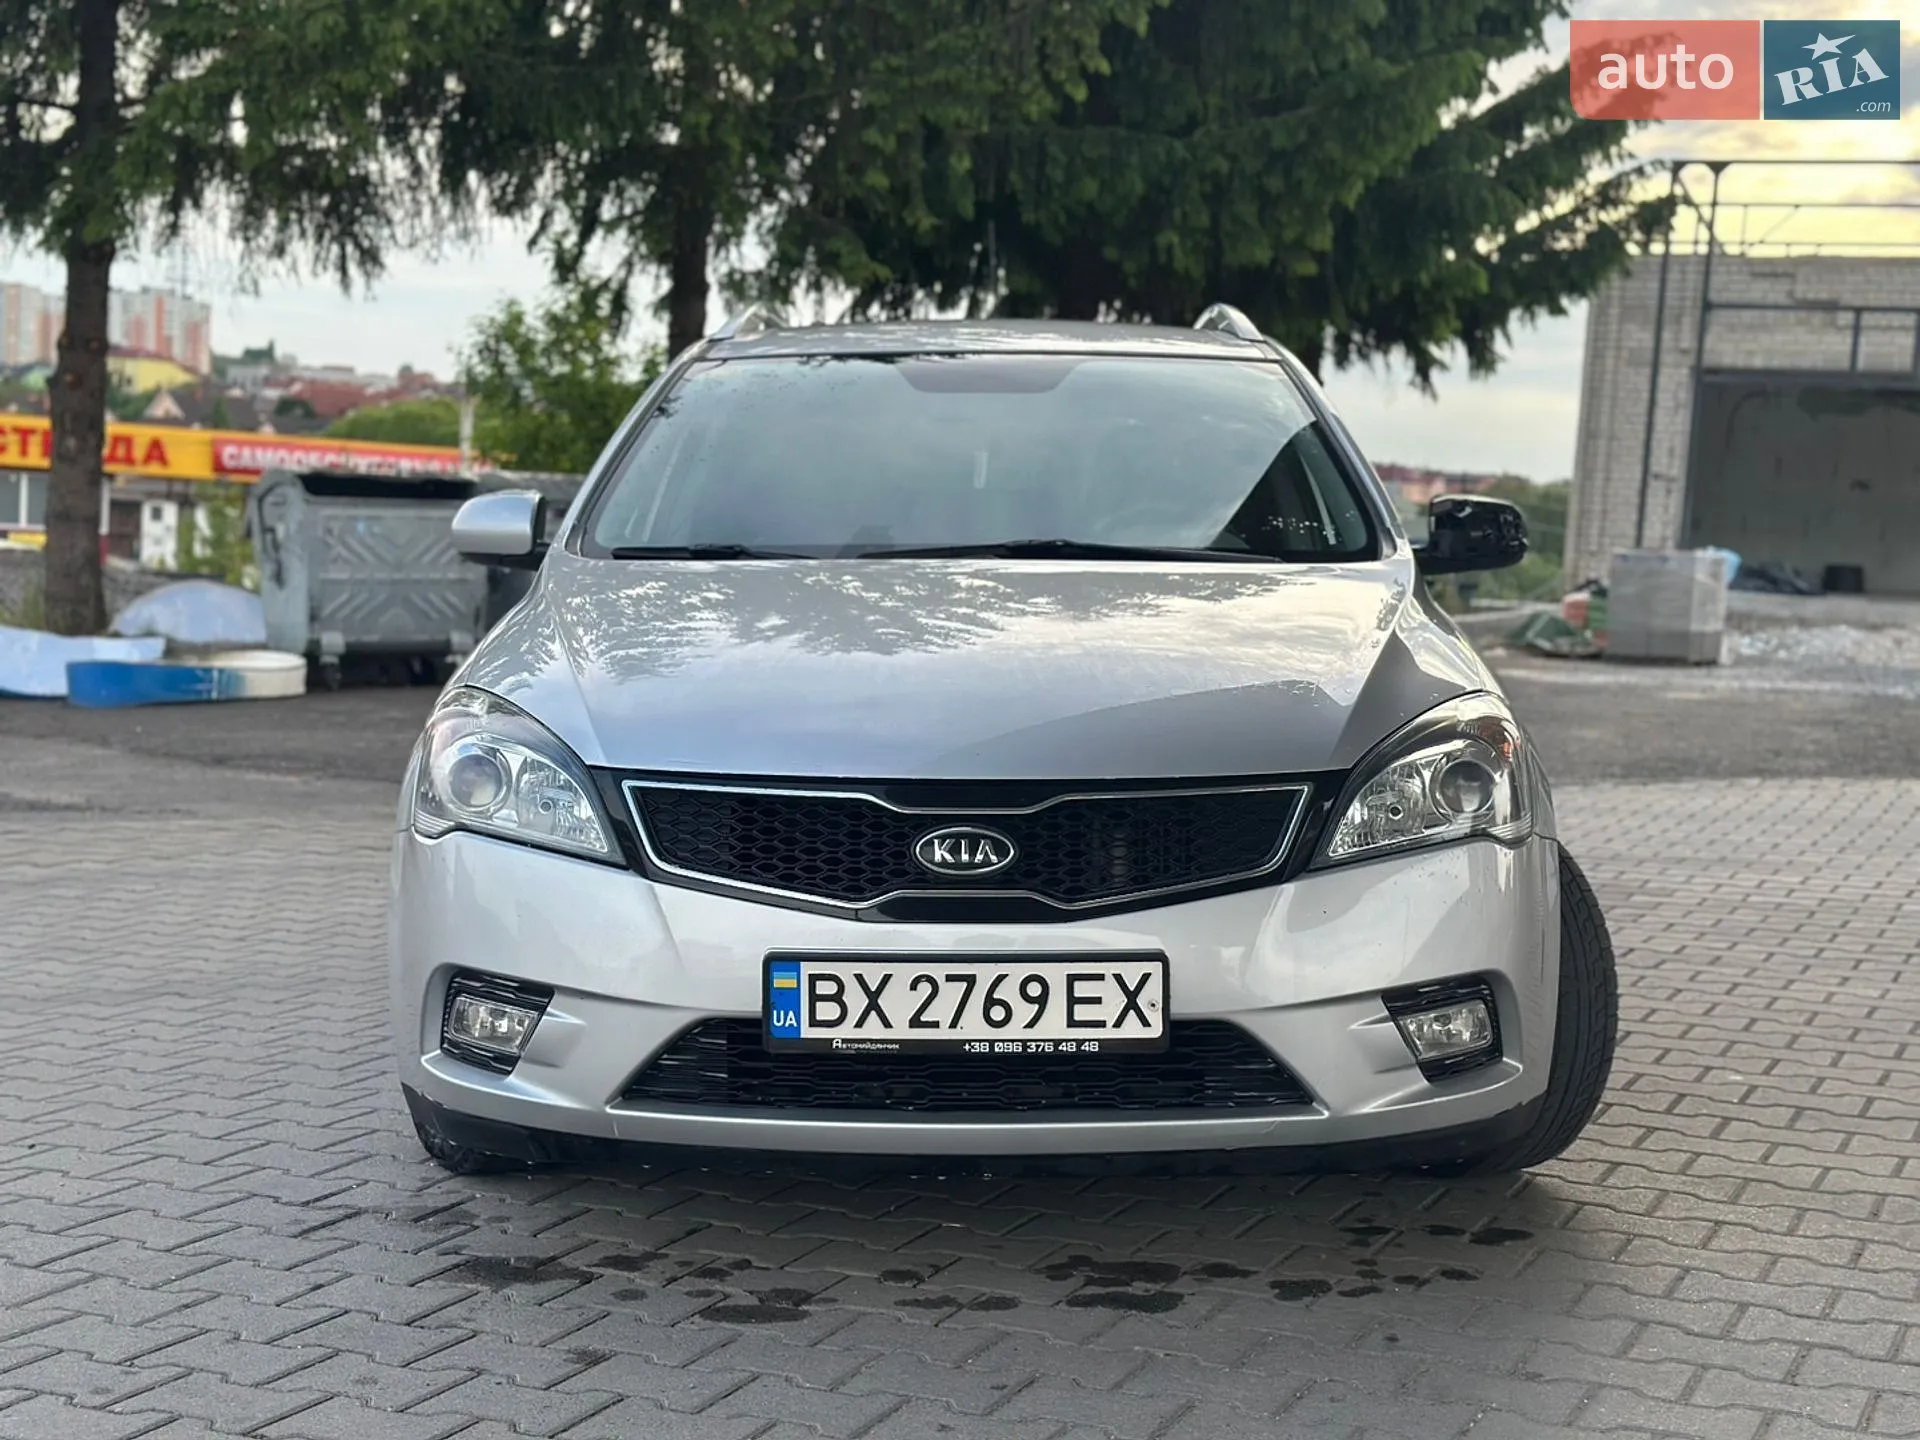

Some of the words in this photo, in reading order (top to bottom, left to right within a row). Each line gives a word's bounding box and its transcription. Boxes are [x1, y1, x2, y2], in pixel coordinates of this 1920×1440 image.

[933, 838, 998, 863] KIA
[807, 972, 894, 1029] BX
[908, 972, 1050, 1029] 2769
[1066, 972, 1153, 1029] EX
[772, 1012, 797, 1028] UA
[963, 1041, 990, 1052] +38
[994, 1041, 1022, 1052] 096
[1026, 1041, 1054, 1052] 376
[1058, 1041, 1076, 1052] 48
[1080, 1041, 1099, 1052] 48
